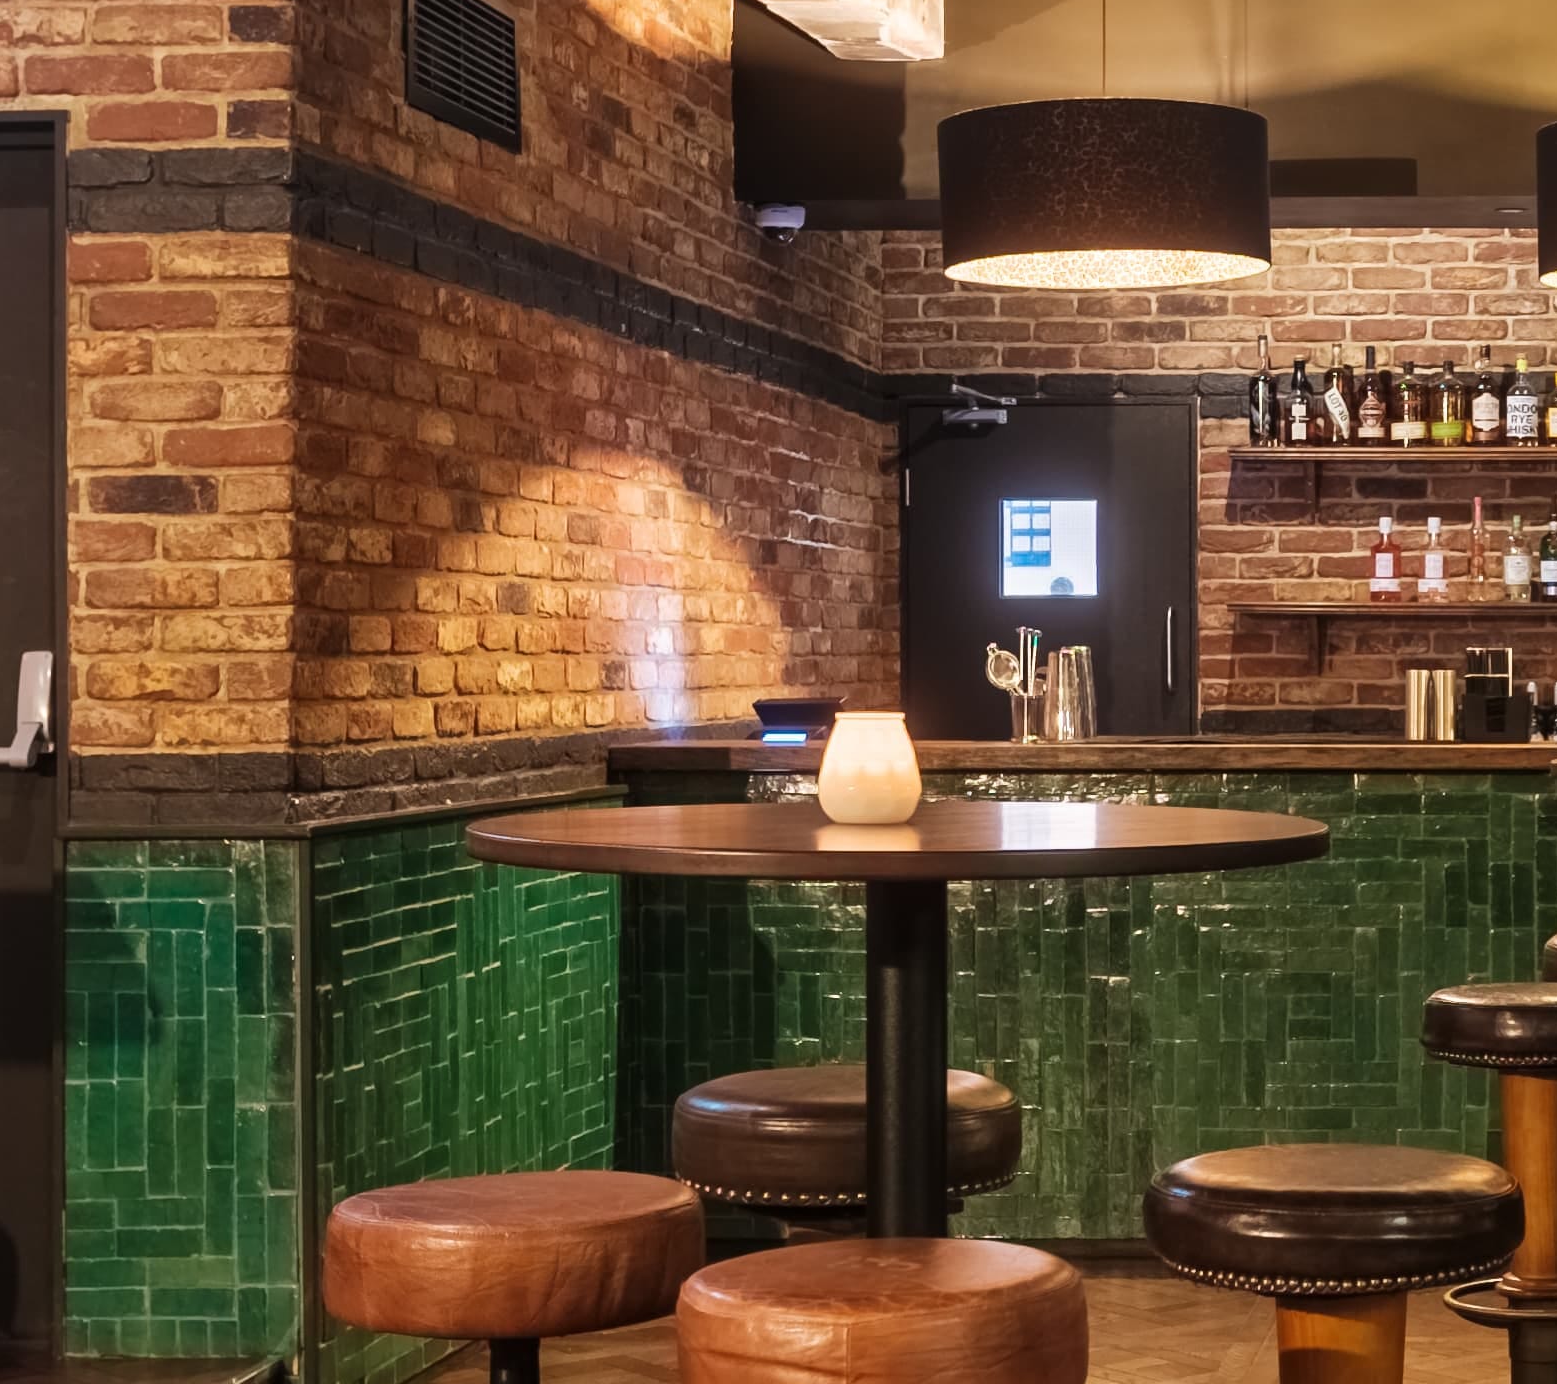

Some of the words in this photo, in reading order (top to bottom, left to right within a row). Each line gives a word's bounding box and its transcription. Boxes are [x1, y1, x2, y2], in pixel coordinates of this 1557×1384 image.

[1507, 403, 1537, 414] ONDO
[1511, 414, 1533, 424] RYE
[1507, 425, 1536, 435] HISK
